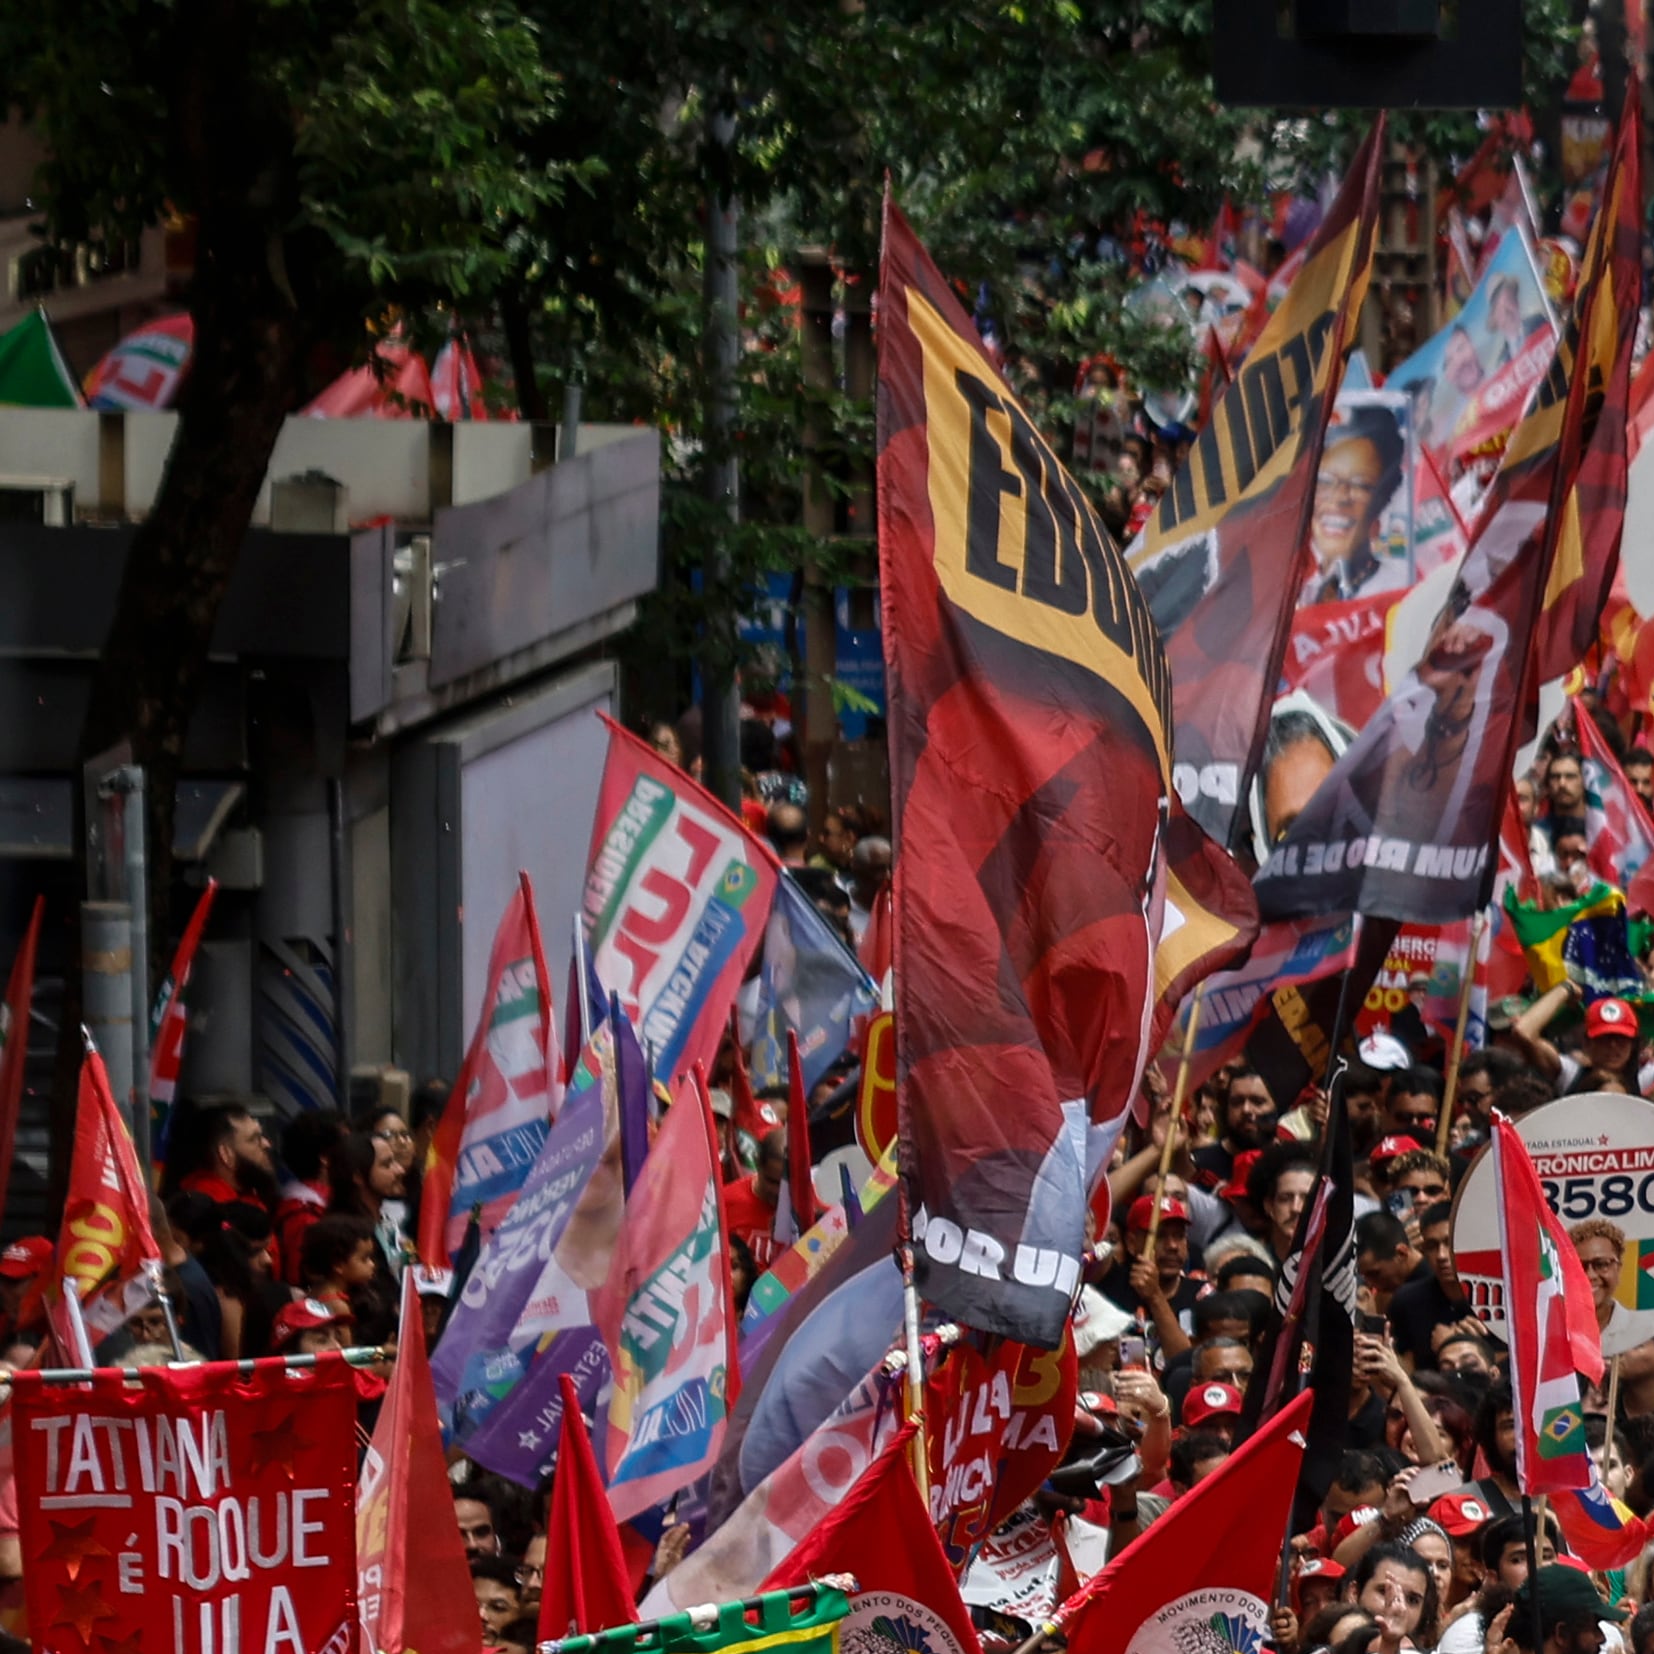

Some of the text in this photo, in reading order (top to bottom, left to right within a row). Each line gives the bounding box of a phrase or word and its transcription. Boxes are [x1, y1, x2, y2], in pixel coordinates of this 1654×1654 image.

[1556, 1136, 1595, 1147] ESTADUAL
[29, 1410, 232, 1502] TATIANA
[155, 1487, 332, 1592] ROQUE
[117, 1533, 145, 1595] É
[894, 1598, 924, 1620] DOS
[1157, 1591, 1265, 1625] MOVIMENTO DOS
